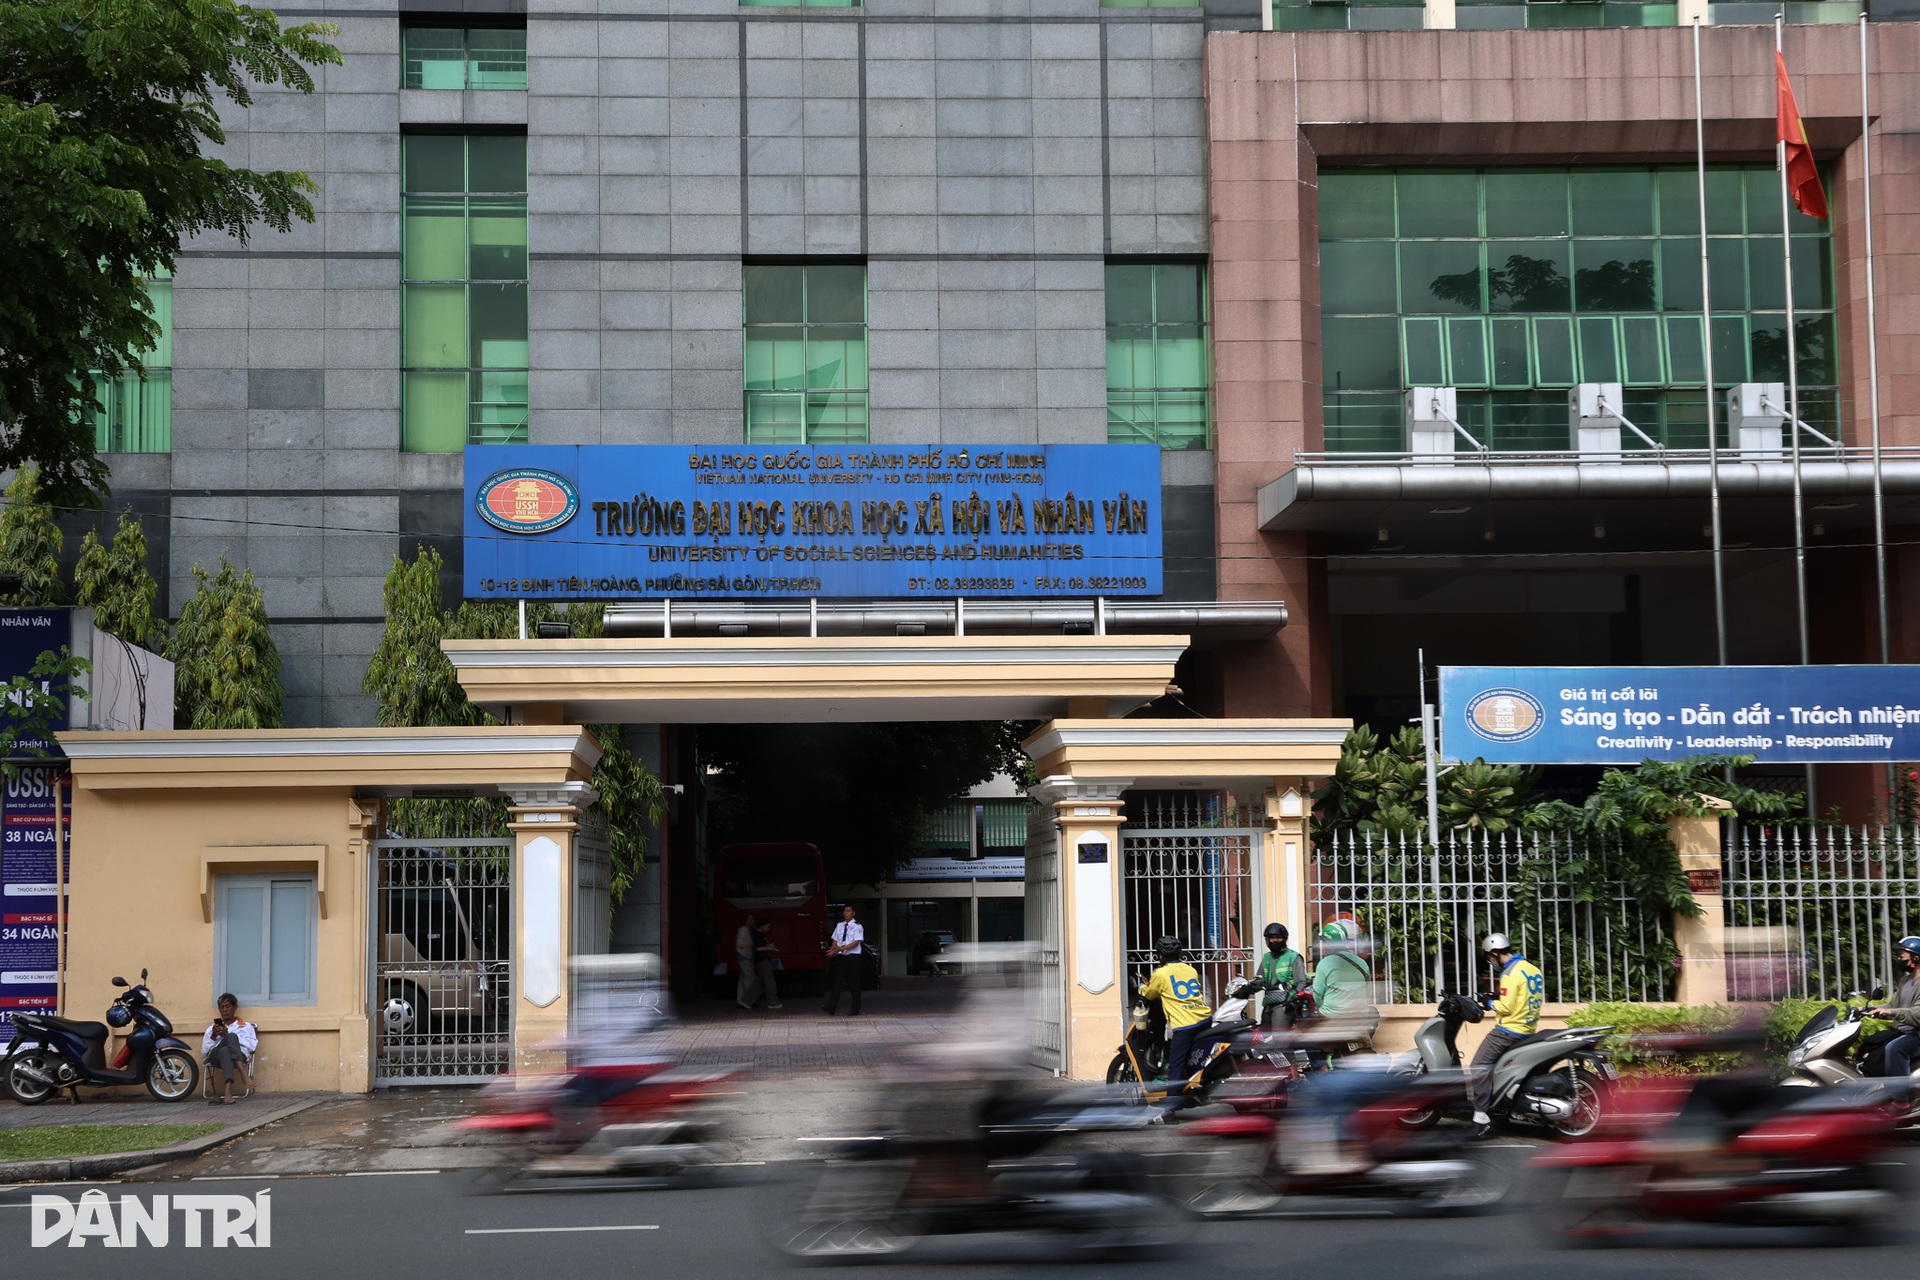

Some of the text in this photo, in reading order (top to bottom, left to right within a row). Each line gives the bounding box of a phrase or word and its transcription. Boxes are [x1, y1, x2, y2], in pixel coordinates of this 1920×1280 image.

[689, 448, 1046, 472] ĐẠI HỌC QUỐC GIA THÀNH PHỐ HỒ CHÍ MINH
[695, 473, 746, 484] VIETNAM
[750, 473, 804, 484] NATIONAL
[809, 473, 873, 484] UNIVERSITY
[884, 473, 900, 483] HO
[904, 473, 922, 483] CHI
[926, 473, 952, 483] MINH
[956, 473, 982, 483] CITY
[985, 473, 1043, 485] (VNU-HCM)
[515, 501, 539, 510] USSH
[592, 491, 1147, 542] TRƯỜNG ĐẠI HỌC KHOA HỌC XÃ HỘI VÀ NHÂN VĂN
[648, 544, 1084, 562] UNIVERSITY OF SOCIAL SCIENCES AND HUMANITIES
[480, 578, 519, 592] 10-12
[522, 578, 555, 593] ĐỊNH
[590, 574, 642, 593] HOÀNG,
[708, 574, 731, 591] SÀI
[908, 577, 931, 589] ĐT:
[934, 577, 1015, 589] 08.38293828
[1035, 576, 1066, 589] FAX:
[1068, 576, 1147, 589] 08.38221903
[1, 616, 51, 626] NHÂN VĂN
[1559, 686, 1658, 704] Giá trị cốt lõi
[1560, 706, 1617, 730] Sáng
[1623, 708, 1661, 730] tạo
[1681, 703, 1726, 725] Dẫn
[1732, 702, 1771, 725] dắt
[1789, 705, 1852, 724] Trách
[1858, 705, 1920, 728] nhiệm
[19, 738, 42, 748] PHÍM
[1596, 735, 1673, 750] Creativity
[1686, 735, 1773, 750] Leadership
[1785, 734, 1894, 749] Responsibility
[6, 830, 21, 842] 38
[1085, 845, 1102, 856] 12
[2, 925, 64, 940] 34 NGÀN
[1170, 974, 1200, 999] be
